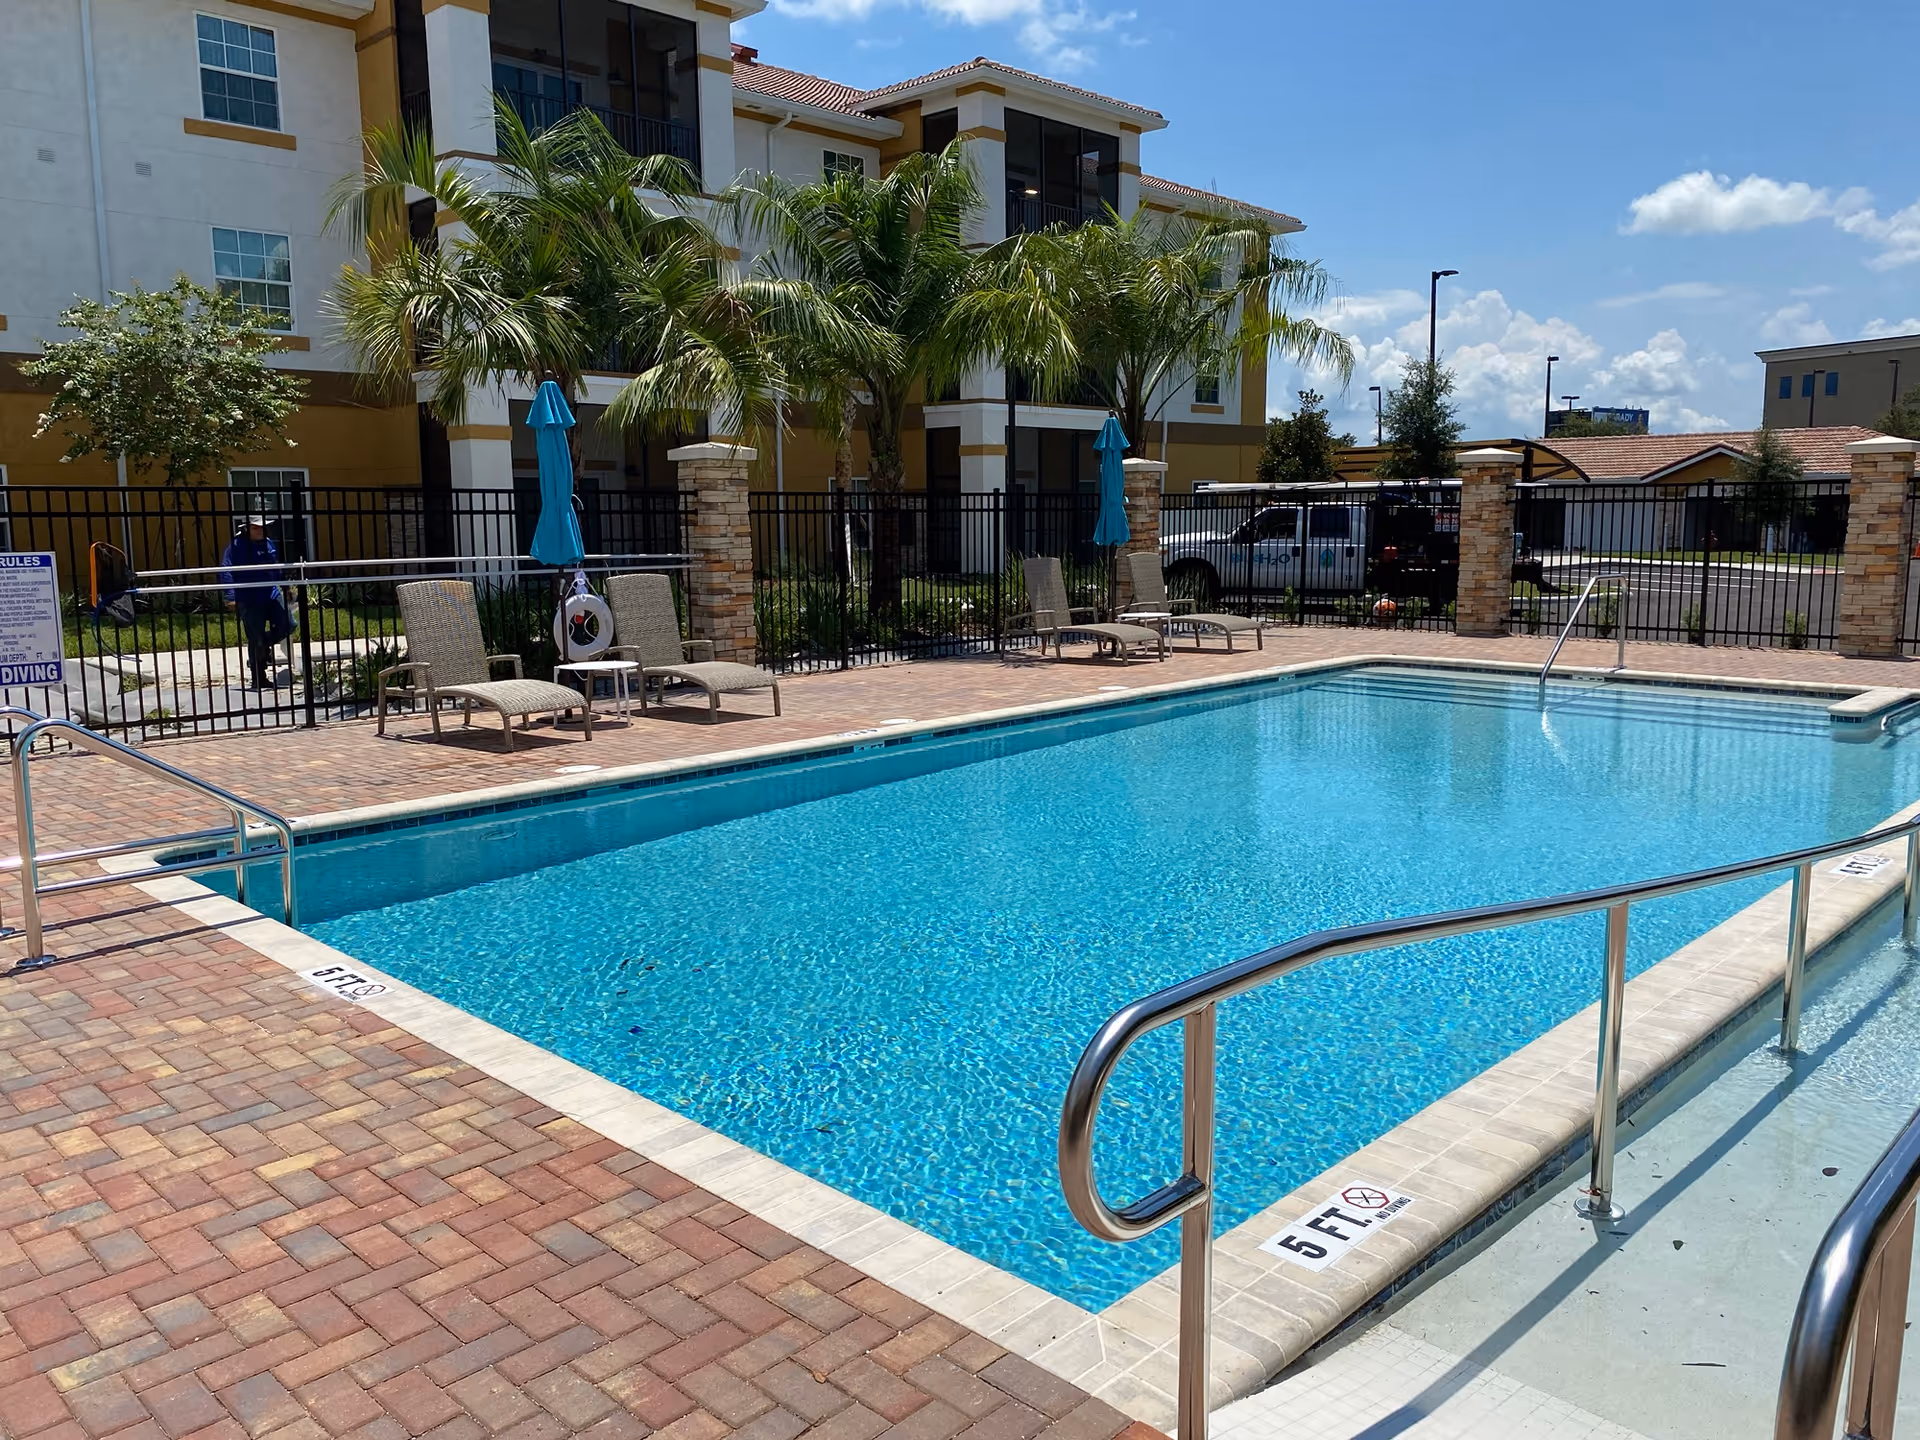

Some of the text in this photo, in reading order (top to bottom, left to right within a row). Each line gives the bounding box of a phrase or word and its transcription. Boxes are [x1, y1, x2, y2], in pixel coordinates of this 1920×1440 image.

[0, 556, 41, 567] RULES
[1, 663, 58, 684] DIVING
[312, 966, 345, 977] 5
[1374, 1196, 1412, 1220] NO DIVING
[1278, 1206, 1373, 1259] 5 FT.
